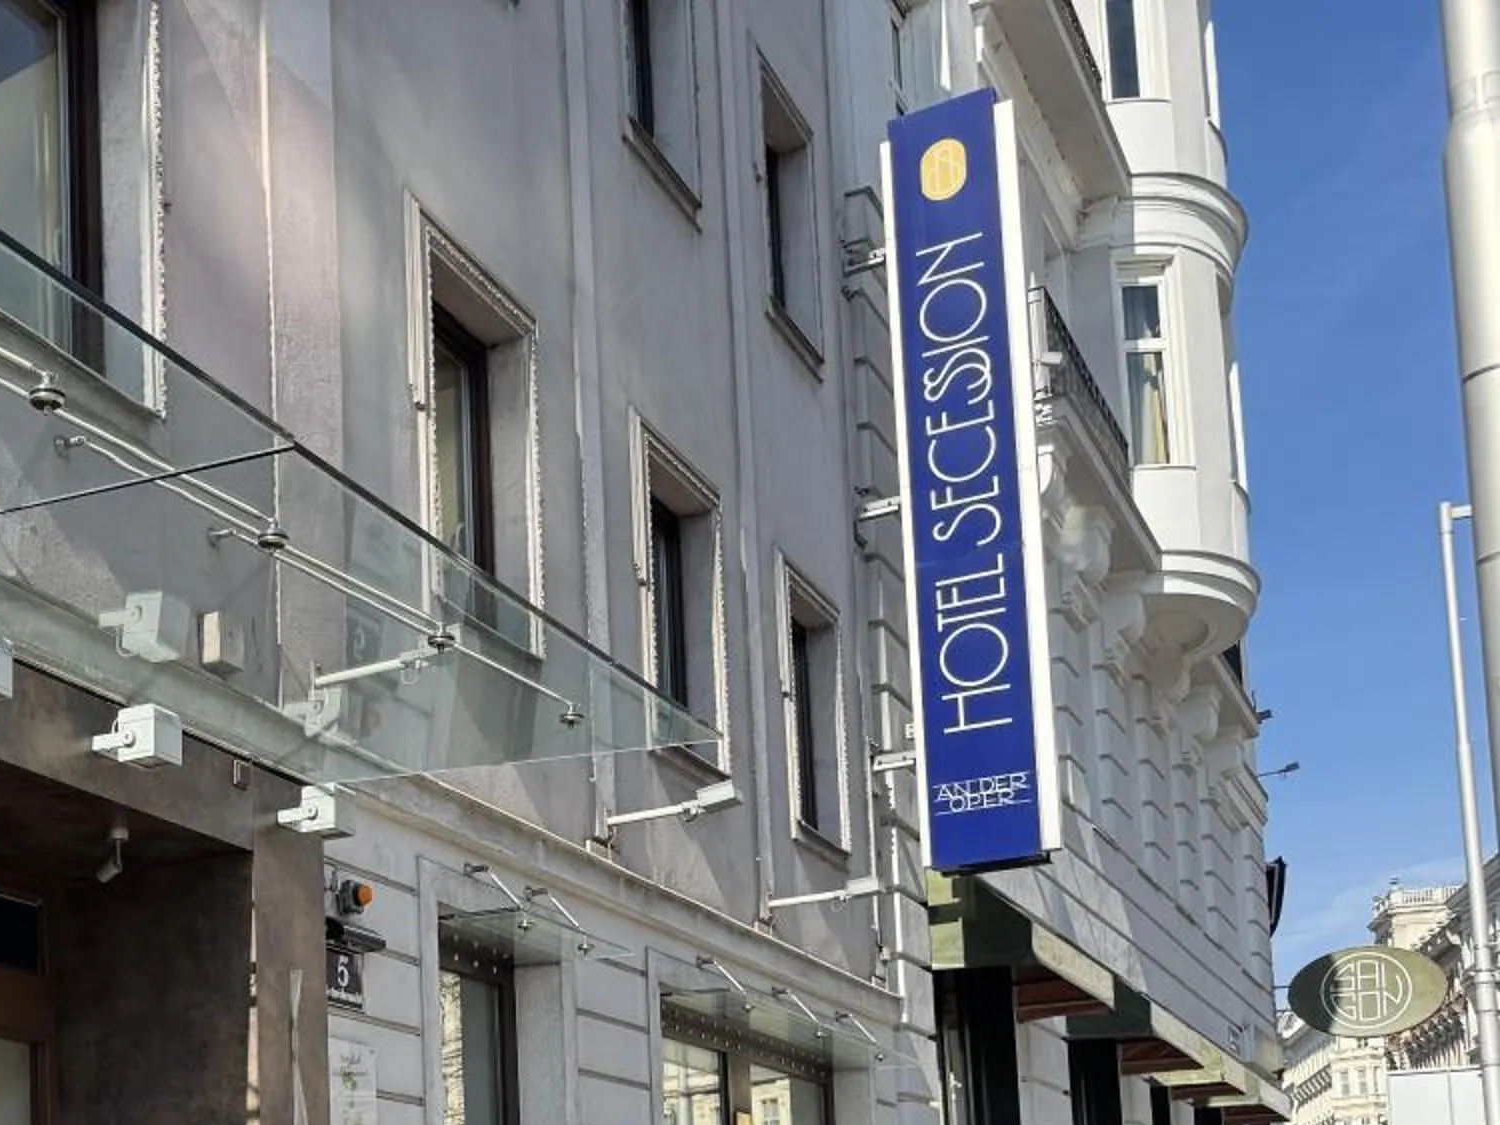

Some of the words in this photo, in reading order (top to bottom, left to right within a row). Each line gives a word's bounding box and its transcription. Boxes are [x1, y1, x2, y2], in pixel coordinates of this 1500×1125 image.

[915, 232, 1001, 546] SECESSION
[936, 553, 1012, 734] HOTEL
[937, 781, 970, 801] AN
[980, 772, 1031, 795] DER
[949, 788, 1017, 812] OPER
